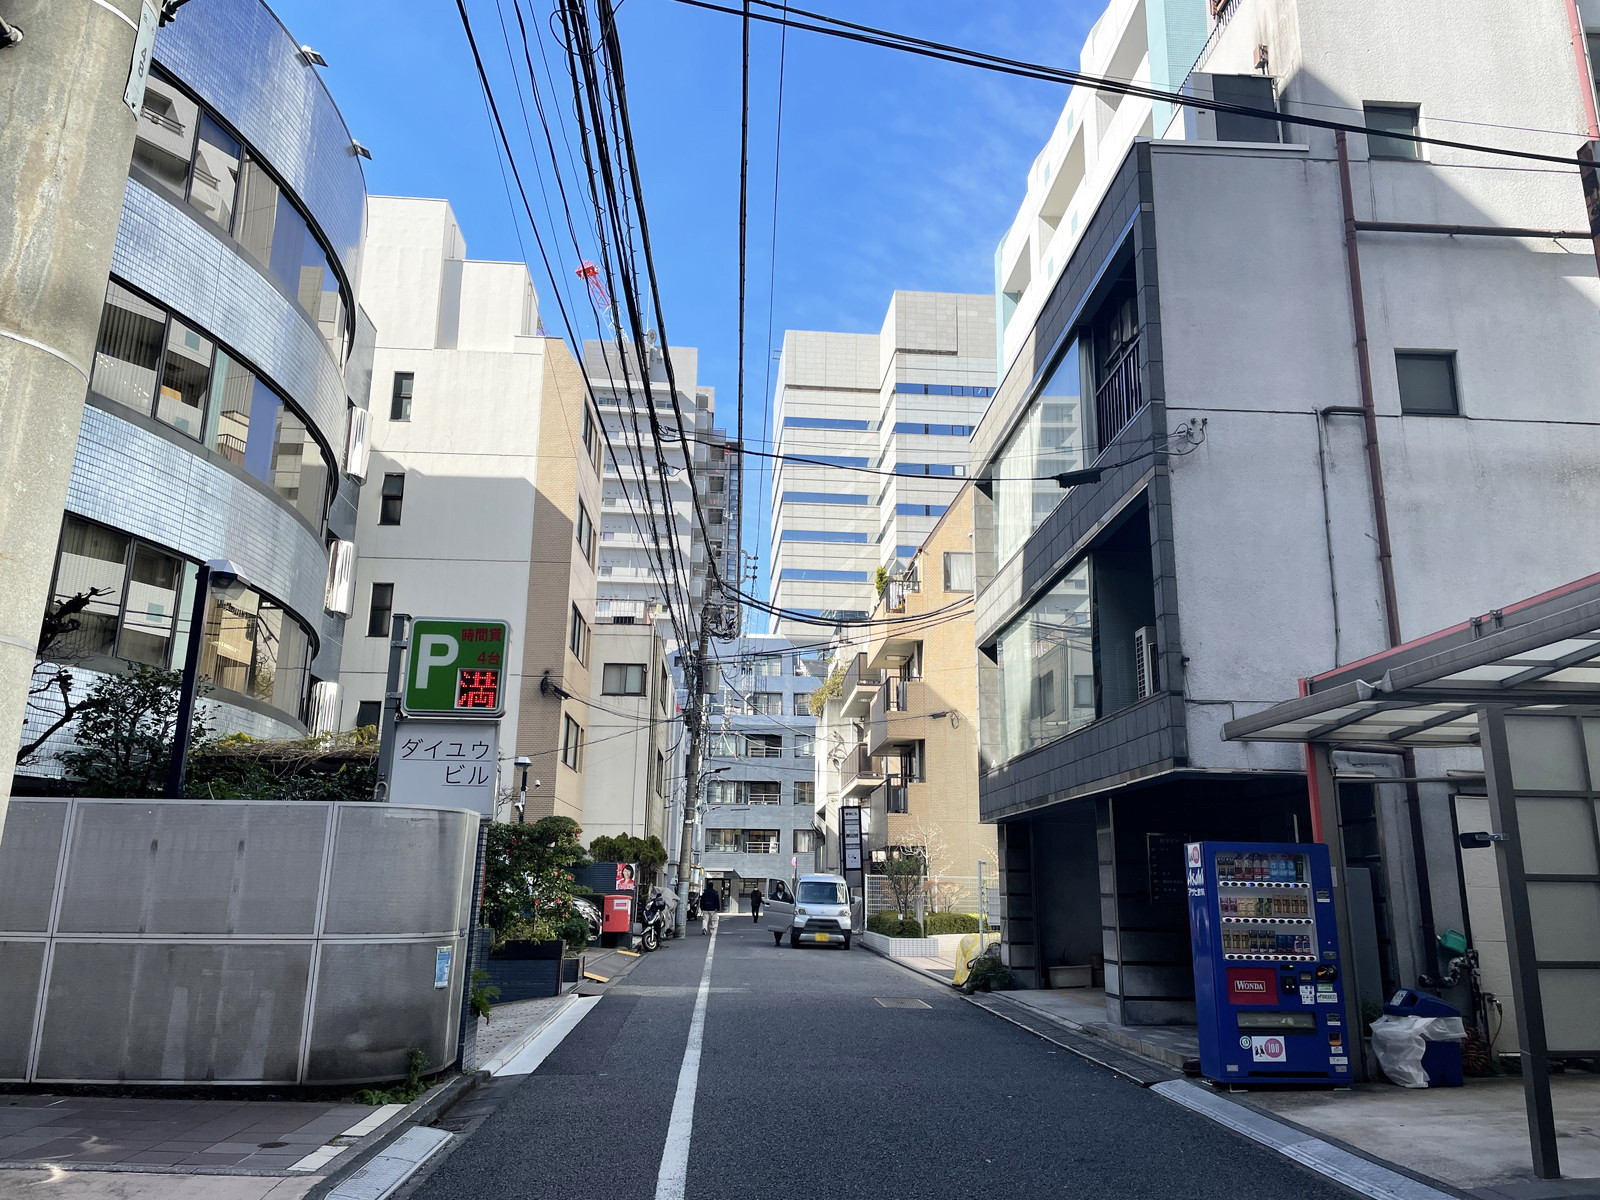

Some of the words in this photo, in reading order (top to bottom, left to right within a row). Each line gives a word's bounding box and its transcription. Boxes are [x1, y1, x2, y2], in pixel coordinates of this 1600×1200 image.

[415, 634, 459, 689] P
[477, 651, 500, 665] 4台
[457, 671, 497, 708] 満
[401, 738, 489, 759] ダイユウ
[446, 765, 489, 785] ビル
